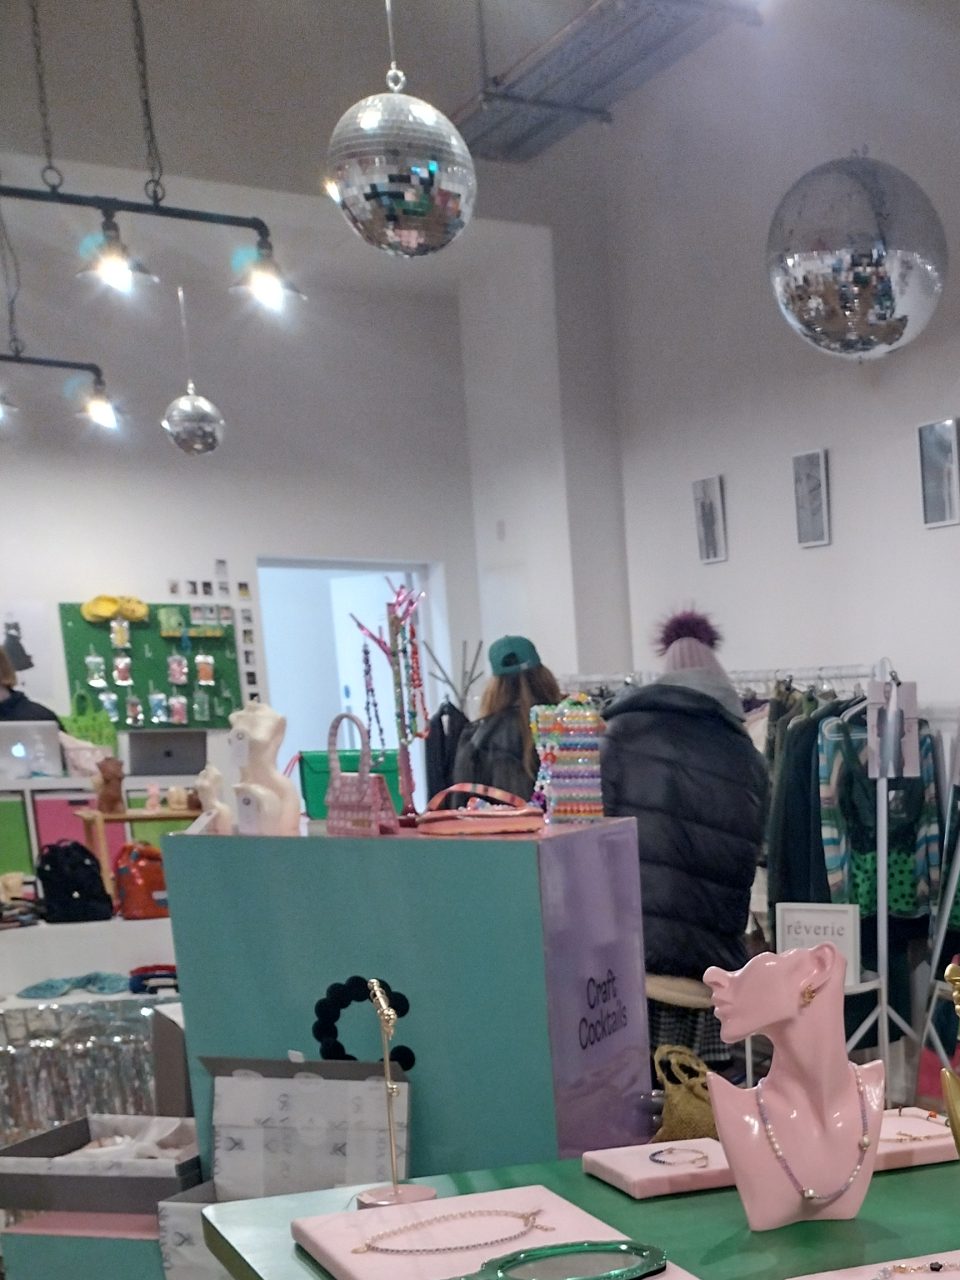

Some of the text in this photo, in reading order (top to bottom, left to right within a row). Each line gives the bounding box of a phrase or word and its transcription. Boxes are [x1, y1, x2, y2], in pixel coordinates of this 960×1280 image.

[786, 921, 846, 937] rêverie
[586, 968, 617, 1010] Craft
[579, 998, 628, 1051] Cocktails
